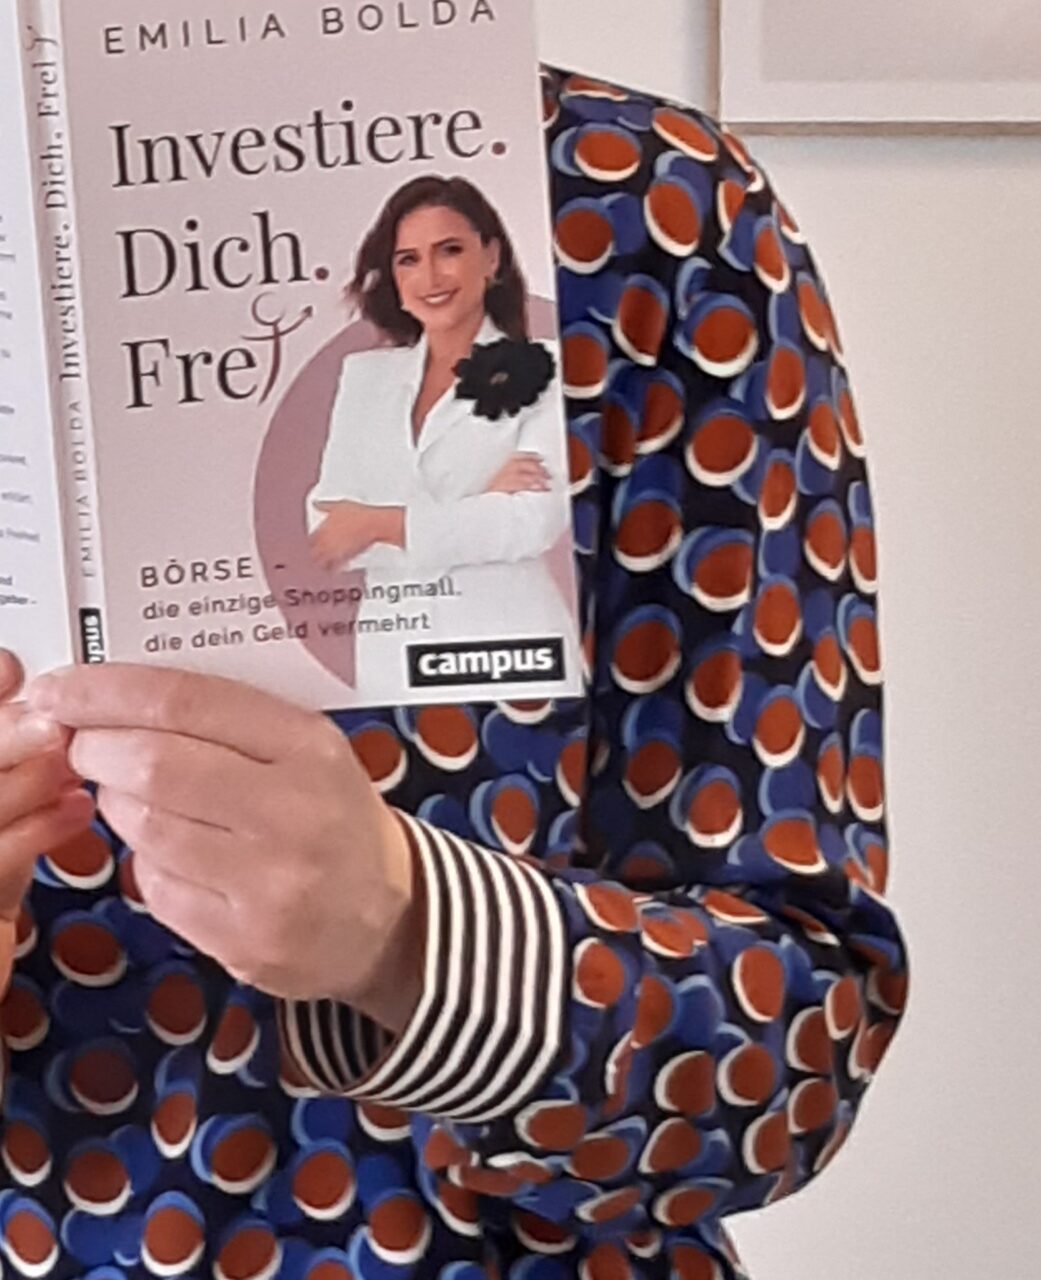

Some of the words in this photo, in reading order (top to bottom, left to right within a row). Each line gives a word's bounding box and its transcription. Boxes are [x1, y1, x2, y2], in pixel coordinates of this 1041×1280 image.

[104, 12, 287, 54] EMILIA
[109, 99, 507, 188] Investiere.
[116, 211, 330, 299] Dich.
[140, 557, 254, 588] BÖRSE
[143, 601, 180, 620] die
[188, 593, 277, 617] einzige
[144, 632, 182, 652] die
[191, 629, 244, 648] dein
[253, 622, 308, 641] Geld
[320, 613, 432, 637] vermehrt
[419, 647, 554, 679] campus
